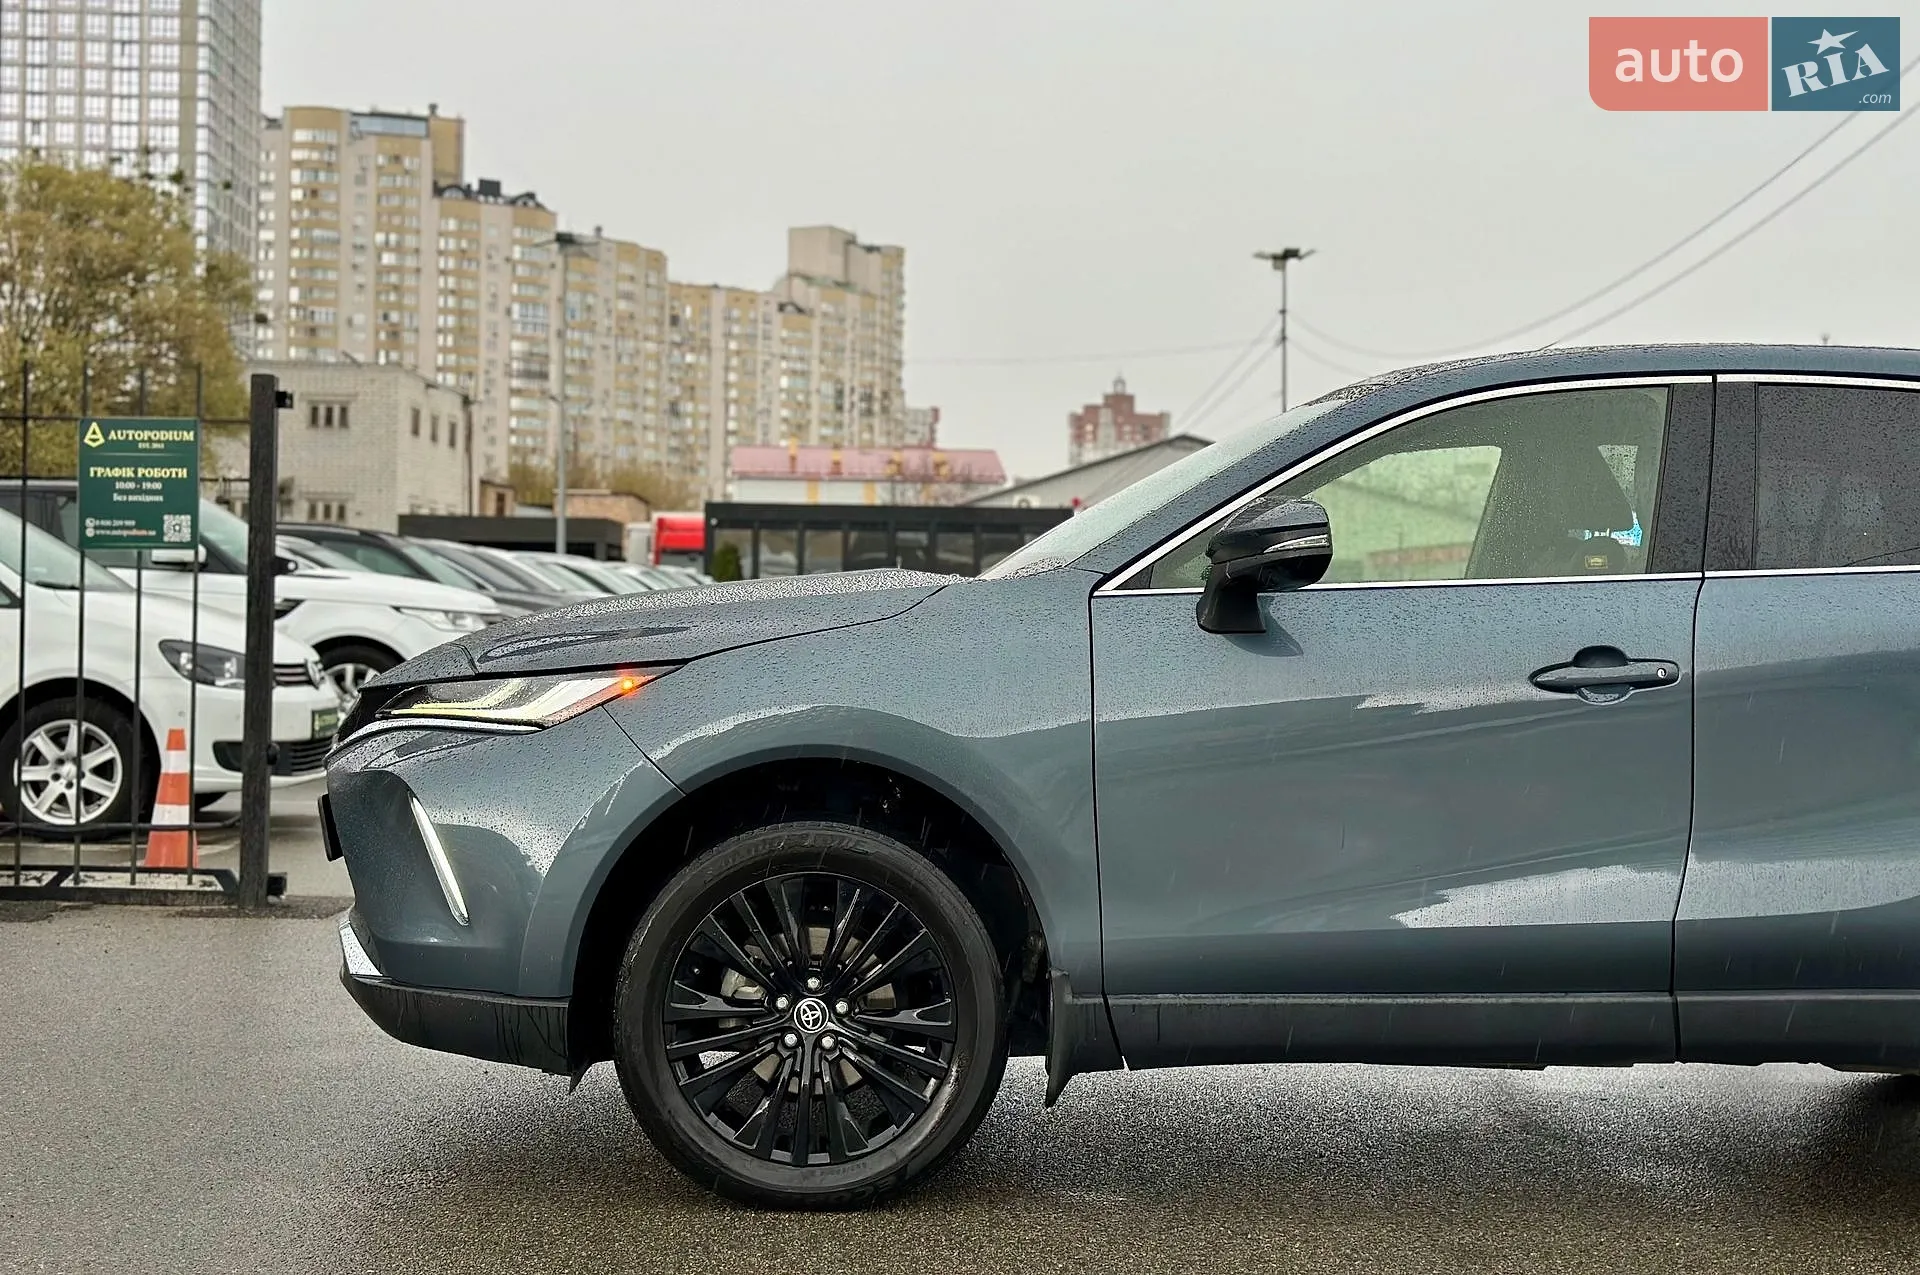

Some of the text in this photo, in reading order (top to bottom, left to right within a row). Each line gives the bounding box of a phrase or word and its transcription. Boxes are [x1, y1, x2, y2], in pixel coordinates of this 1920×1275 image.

[108, 429, 195, 441] AUTOPODIUM
[89, 466, 188, 479] ГРАФІК РОБОТИ
[115, 481, 136, 490] 10:00
[142, 481, 162, 490] 19:00
[113, 492, 127, 502] Без
